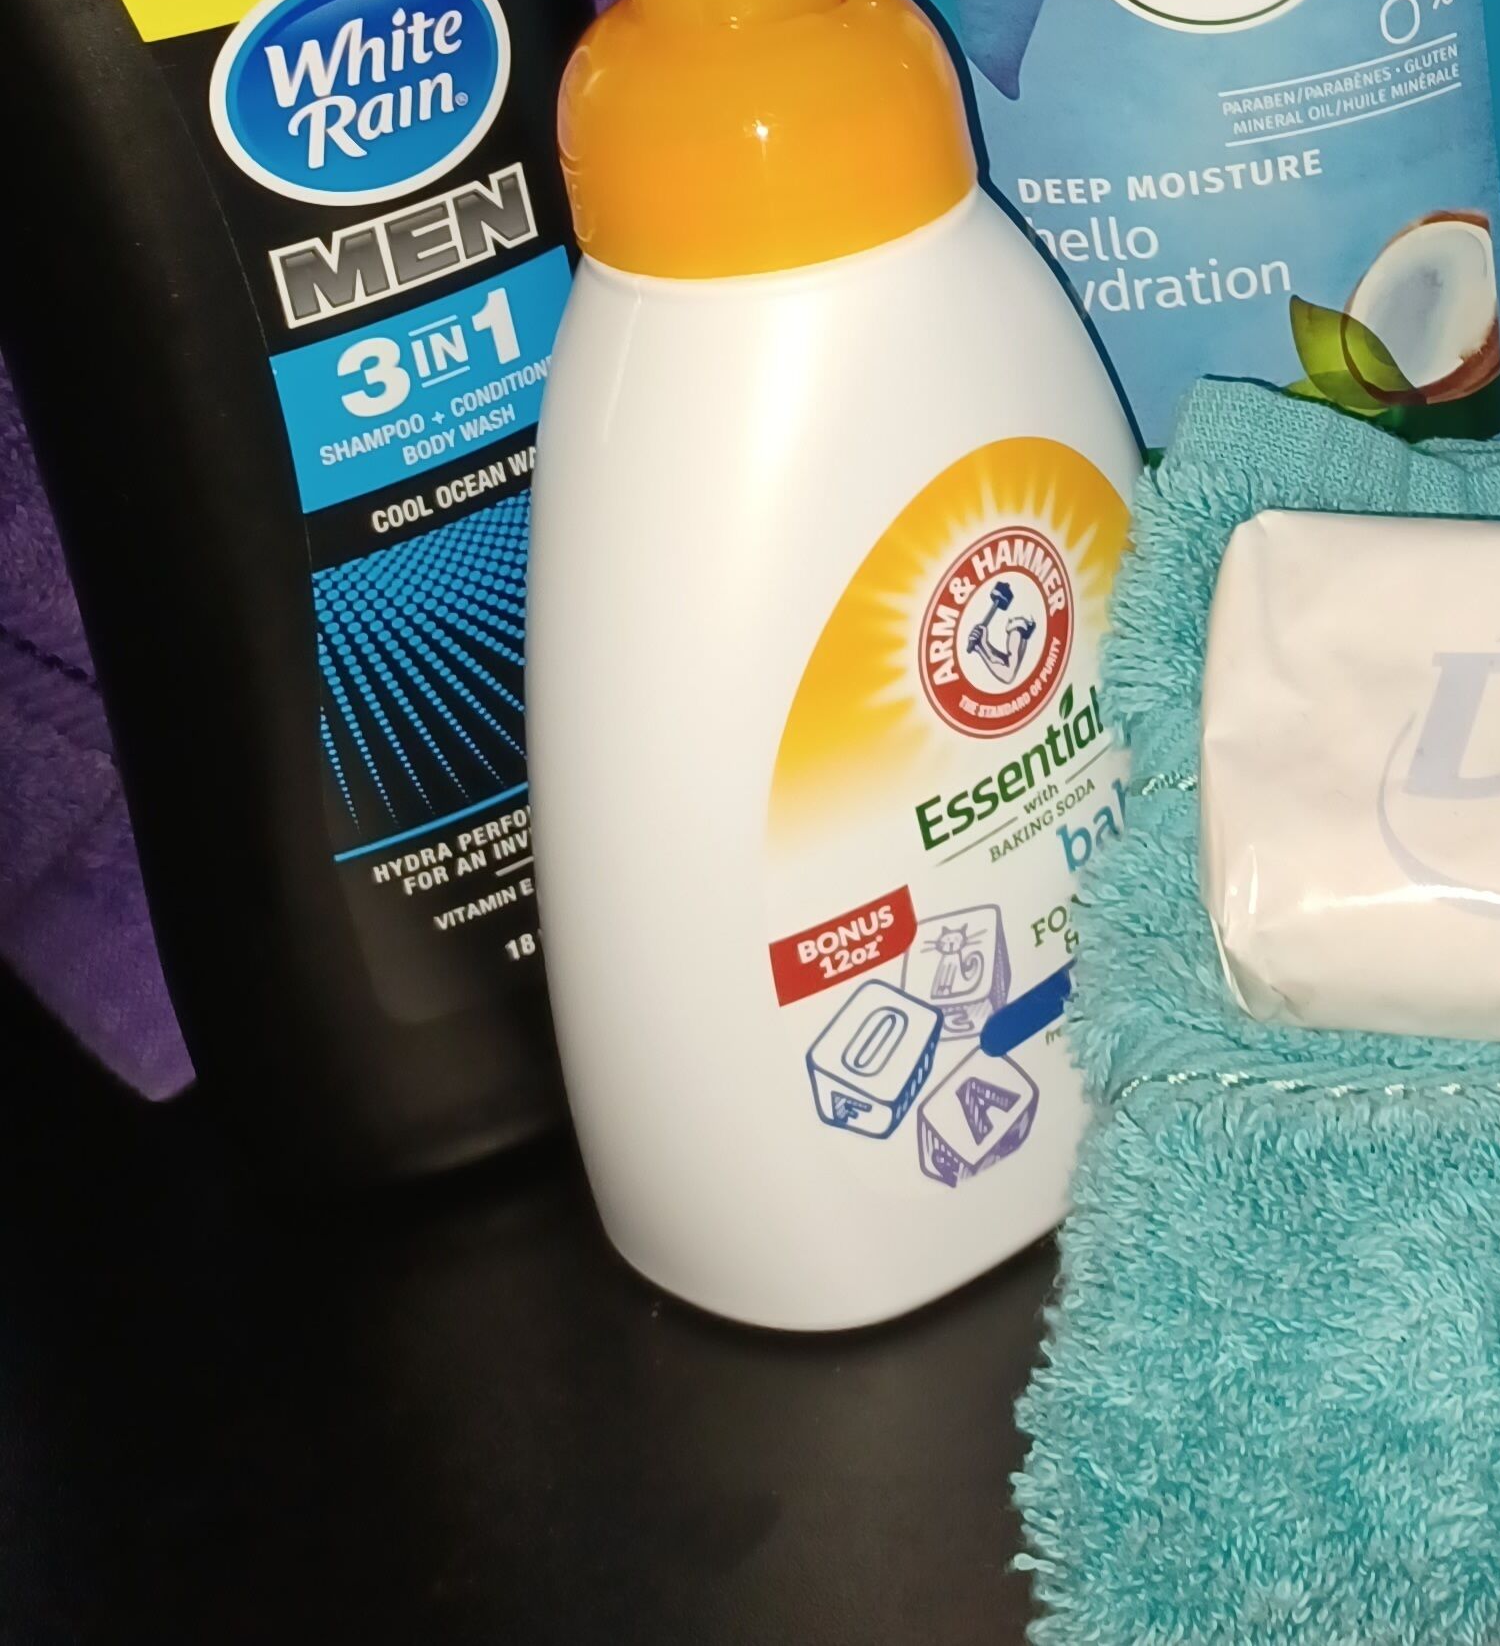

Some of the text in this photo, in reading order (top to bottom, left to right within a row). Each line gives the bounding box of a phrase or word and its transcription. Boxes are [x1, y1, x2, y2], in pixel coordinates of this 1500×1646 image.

[264, 8, 463, 108] White
[1404, 43, 1458, 75] GLUTEN
[1233, 110, 1304, 135] MINERAL
[1017, 149, 1322, 204] DEEP MOISTURE
[268, 162, 539, 330] MEN
[337, 287, 521, 417] 3 IN 1
[320, 413, 425, 466] SHAMPOO
[402, 403, 516, 466] BODY WASH
[371, 495, 434, 533] COOL
[435, 461, 507, 509] OCEAN
[928, 538, 1066, 686] ARM & HAMMER
[989, 778, 1096, 863] BAKING SODA
[1023, 782, 1060, 815] with
[373, 804, 531, 883] HYDRA PERFO
[403, 827, 532, 896] FOR AN INV
[433, 877, 535, 931] VITAMIN E
[797, 905, 894, 964] BONUS
